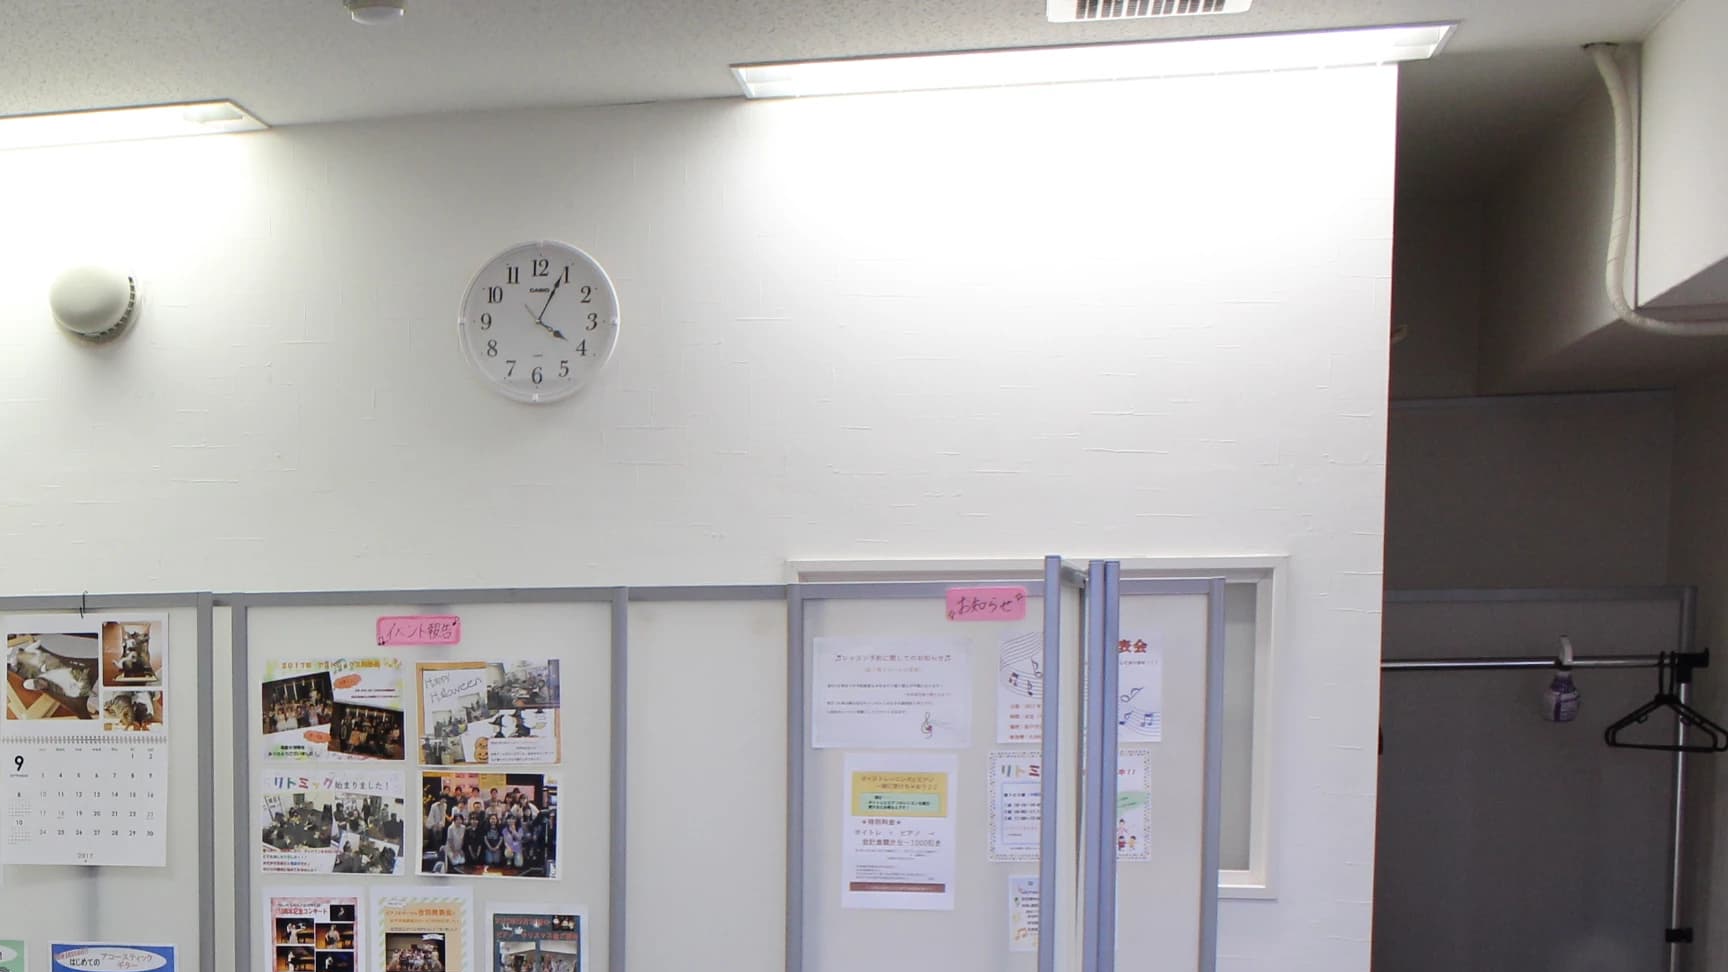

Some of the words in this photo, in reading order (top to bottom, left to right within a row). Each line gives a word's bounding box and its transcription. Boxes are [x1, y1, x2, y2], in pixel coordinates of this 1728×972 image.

[506, 266, 520, 285] 11
[532, 258, 549, 278] 12
[564, 266, 570, 284] 1
[487, 286, 503, 304] 10
[580, 285, 592, 304] 2
[480, 312, 492, 331] 9
[585, 312, 598, 331] 3
[487, 339, 498, 358] 8
[575, 339, 587, 357] 4
[505, 360, 516, 377] 7
[531, 367, 543, 385] 6
[558, 360, 569, 378] 5
[956, 595, 1012, 615] お知らせ
[14, 755, 25, 772] 9
[69, 958, 100, 967] はじめての
